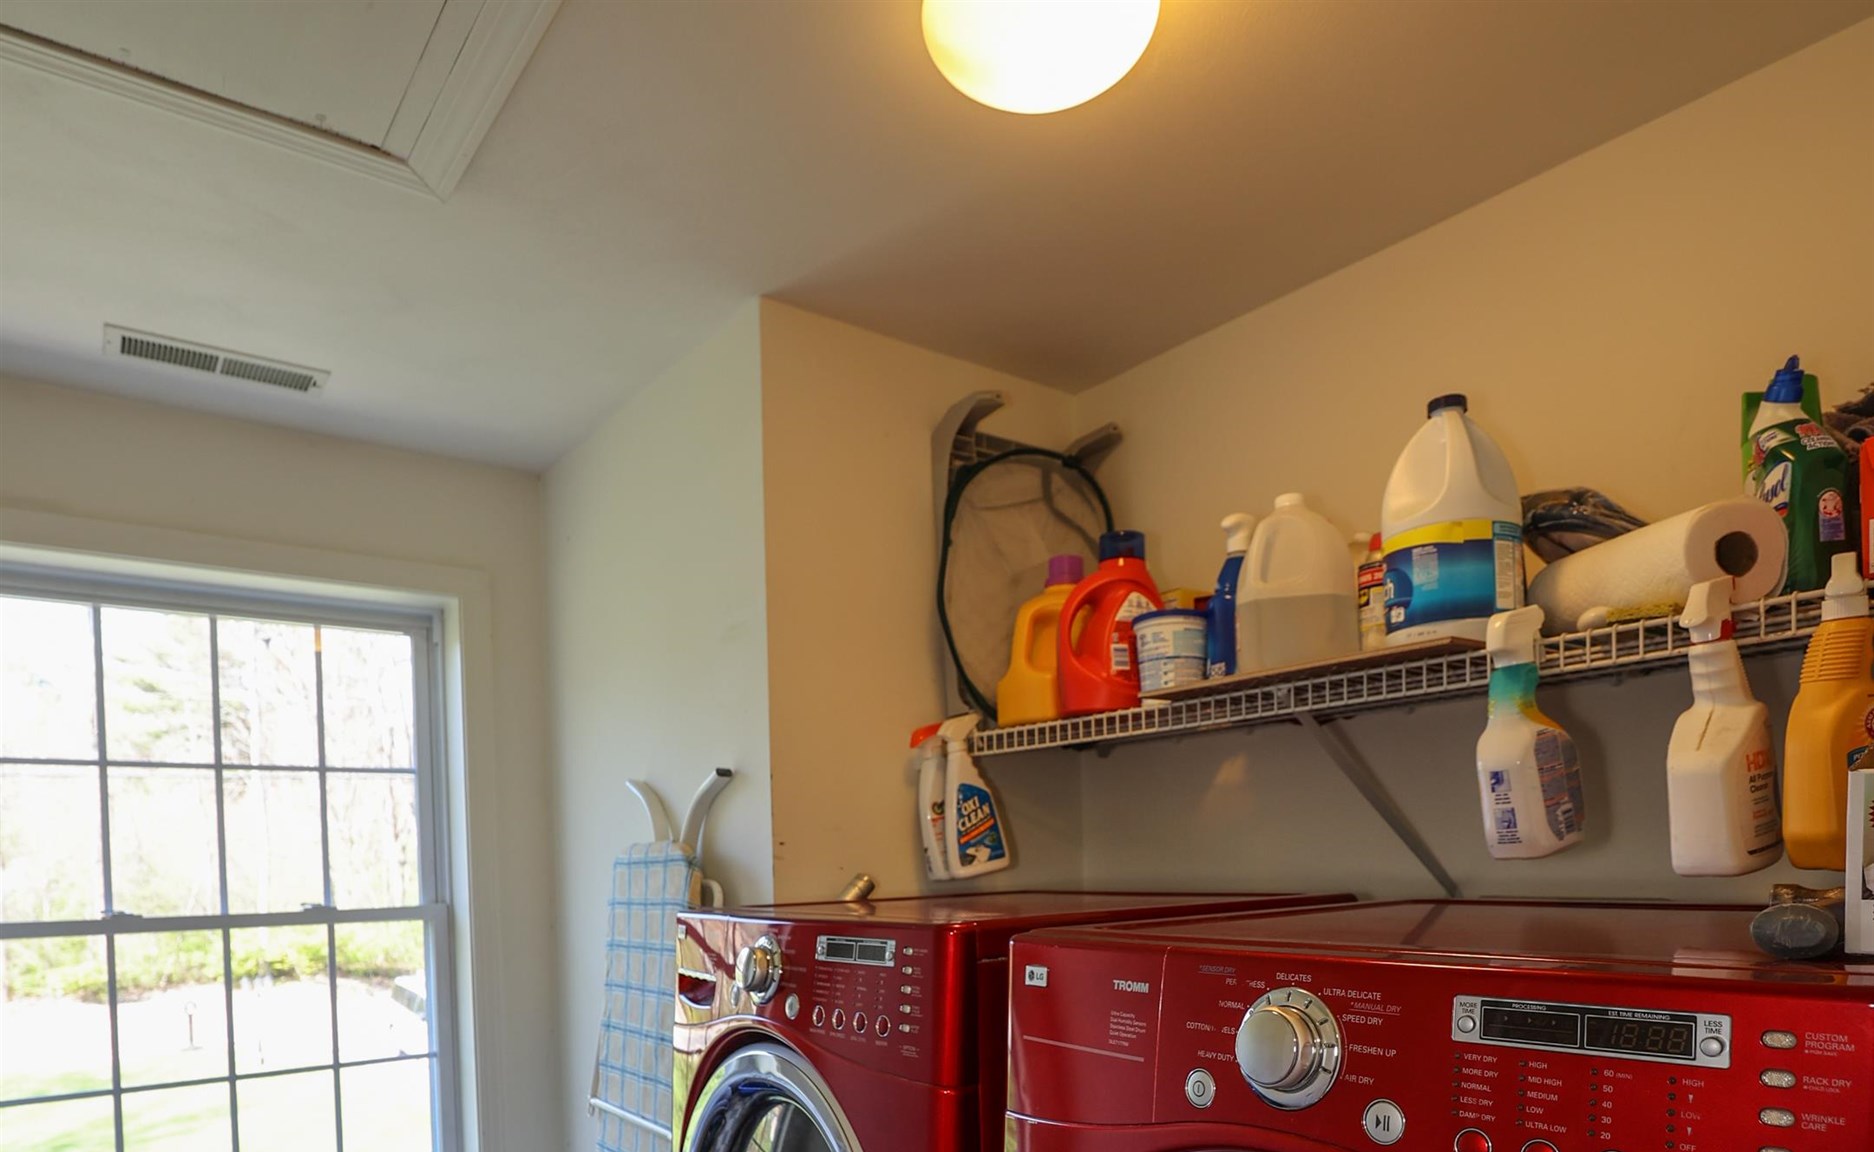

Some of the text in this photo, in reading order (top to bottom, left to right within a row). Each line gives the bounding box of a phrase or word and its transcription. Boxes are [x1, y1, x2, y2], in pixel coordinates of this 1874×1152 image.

[961, 796, 980, 815] OXI
[958, 802, 990, 832] CLEAN
[1276, 972, 1312, 982] DELICATES
[1113, 980, 1149, 993] TROMM
[1323, 988, 1382, 1001] ULTRA DELICATE
[1219, 1000, 1245, 1010] NORMAL
[1386, 1004, 1401, 1013] DRY
[1342, 1013, 1383, 1025] SPEED DRY
[1634, 1012, 1671, 1020] REMAINING
[1703, 1020, 1723, 1028] LESS
[1705, 1027, 1723, 1035] TIME
[1805, 1032, 1848, 1043] CUSTOM
[1348, 1044, 1397, 1058] FRESHEN UP
[1805, 1040, 1855, 1052] PROGRAM
[1198, 1049, 1234, 1062] HEAVY DUTY
[1463, 1053, 1498, 1063] VERY DRY
[1528, 1061, 1548, 1069] HIGH
[1462, 1067, 1499, 1079] MORE DRY
[1603, 1069, 1633, 1080] 60 (MIN)
[1344, 1073, 1374, 1085] AIR DRY
[1527, 1076, 1562, 1087] MID HIGH
[1682, 1078, 1705, 1088] HIGH
[1803, 1076, 1852, 1088] RACK DRY
[1461, 1082, 1492, 1092] NORMAL
[1602, 1085, 1613, 1093] 50
[1526, 1091, 1558, 1101] MEDIUM
[1460, 1096, 1494, 1107] LESS DRY
[1602, 1101, 1612, 1109] 40
[1526, 1106, 1544, 1114] LOW
[1481, 1113, 1496, 1122] DRY
[1601, 1116, 1612, 1124] 30
[1801, 1113, 1845, 1125] WRINKLE
[1525, 1120, 1567, 1133] ULTRA LOW
[1801, 1122, 1827, 1132] CARE
[1600, 1131, 1611, 1140] 20
[1679, 1143, 1696, 1152] OFF
